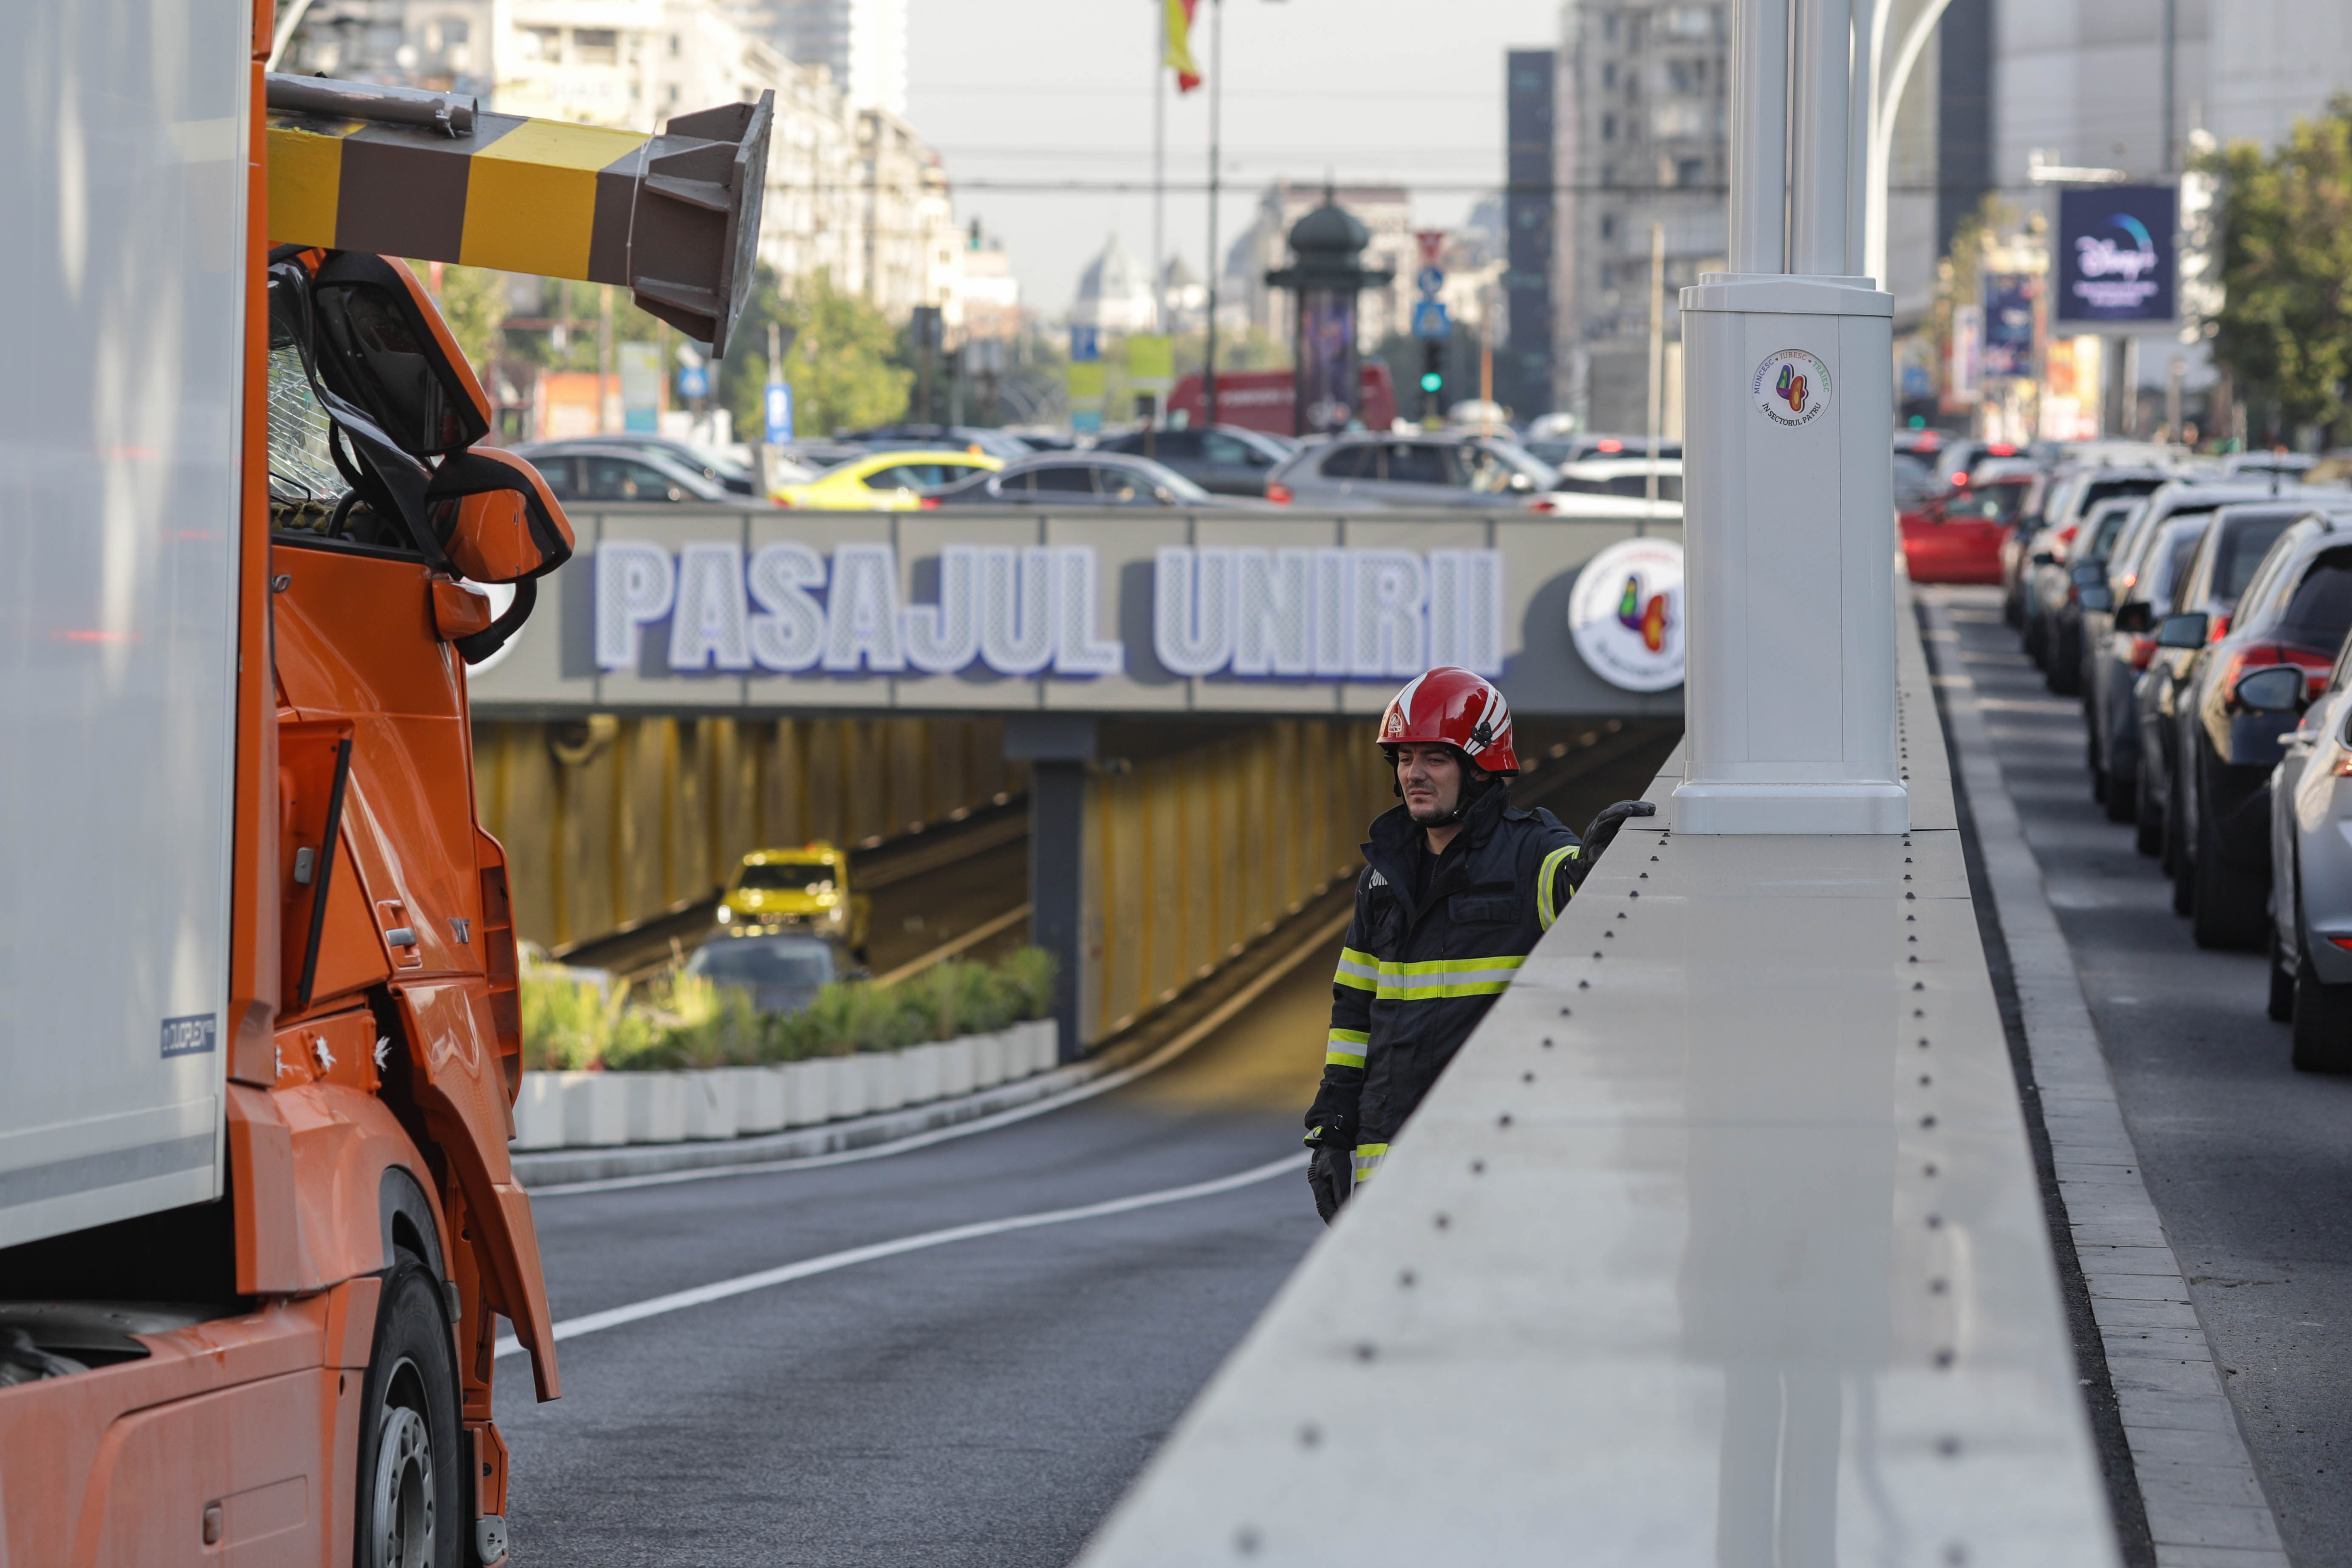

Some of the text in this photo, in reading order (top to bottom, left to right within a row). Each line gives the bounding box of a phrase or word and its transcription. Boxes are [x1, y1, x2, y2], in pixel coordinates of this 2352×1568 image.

[1754, 352, 1829, 394] MUNCESC IUBESC TRĂIESC
[1762, 402, 1821, 426] ÎN SECTORUL PATRU
[596, 540, 1124, 675] PASAJUL
[1153, 546, 1504, 676] UNIRII
